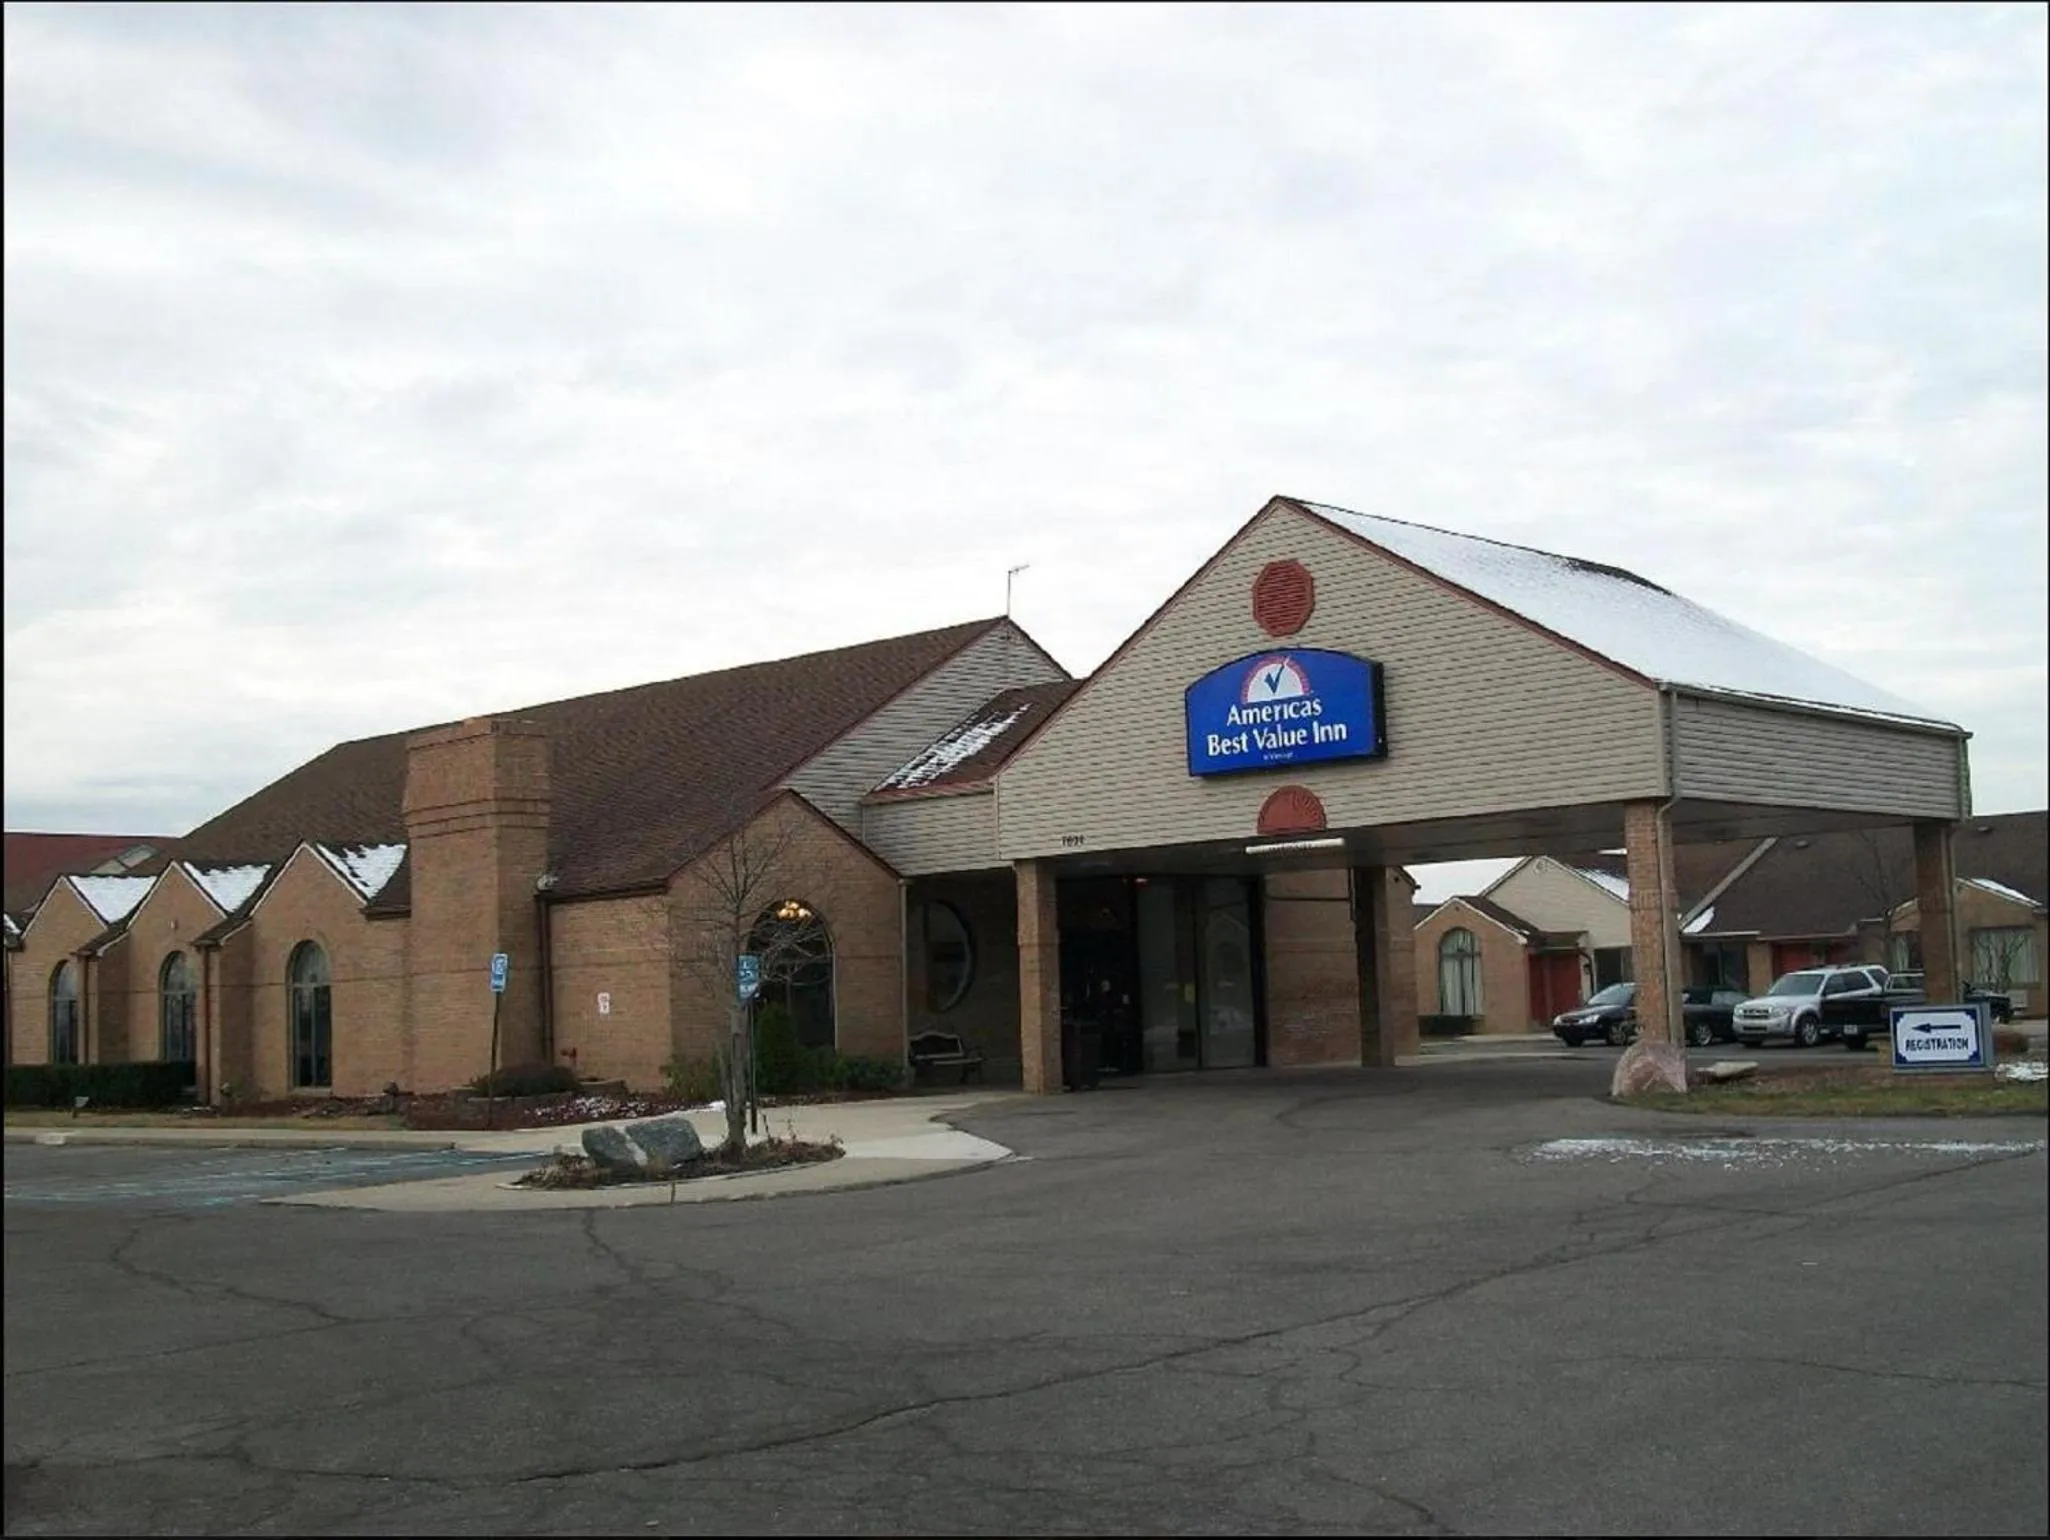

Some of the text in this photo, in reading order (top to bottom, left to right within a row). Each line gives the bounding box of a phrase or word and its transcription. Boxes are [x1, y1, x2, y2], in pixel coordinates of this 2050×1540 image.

[1227, 699, 1322, 726] Americas
[1207, 730, 1248, 756] Best
[1253, 724, 1307, 750] Value
[1312, 721, 1347, 744] Inn
[1905, 1037, 1969, 1052] REGISTRATION
